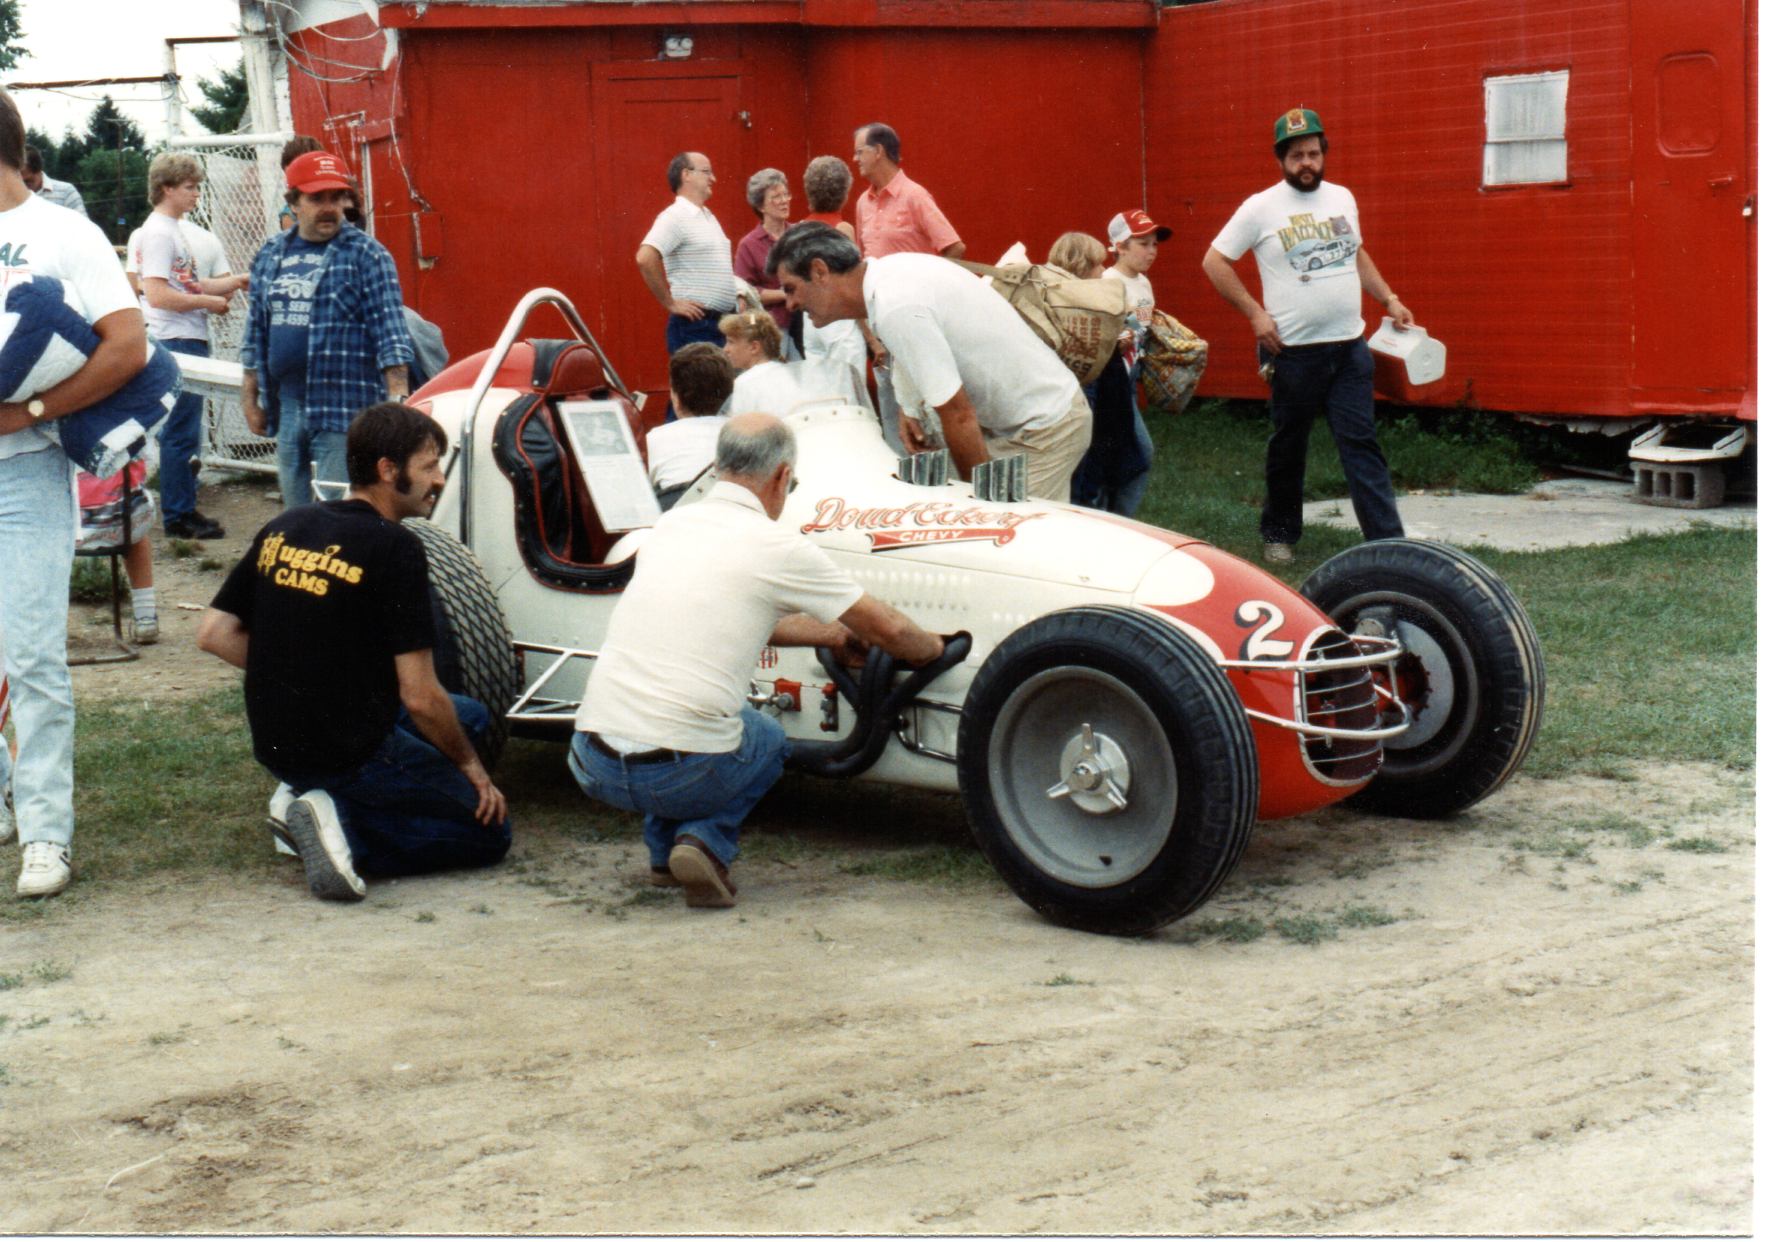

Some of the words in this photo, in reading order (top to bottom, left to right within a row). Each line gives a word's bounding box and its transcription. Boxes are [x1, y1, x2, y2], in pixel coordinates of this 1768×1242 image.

[898, 529, 964, 542] CHEVY
[274, 567, 329, 596] CAMS
[1236, 600, 1294, 662] 2
